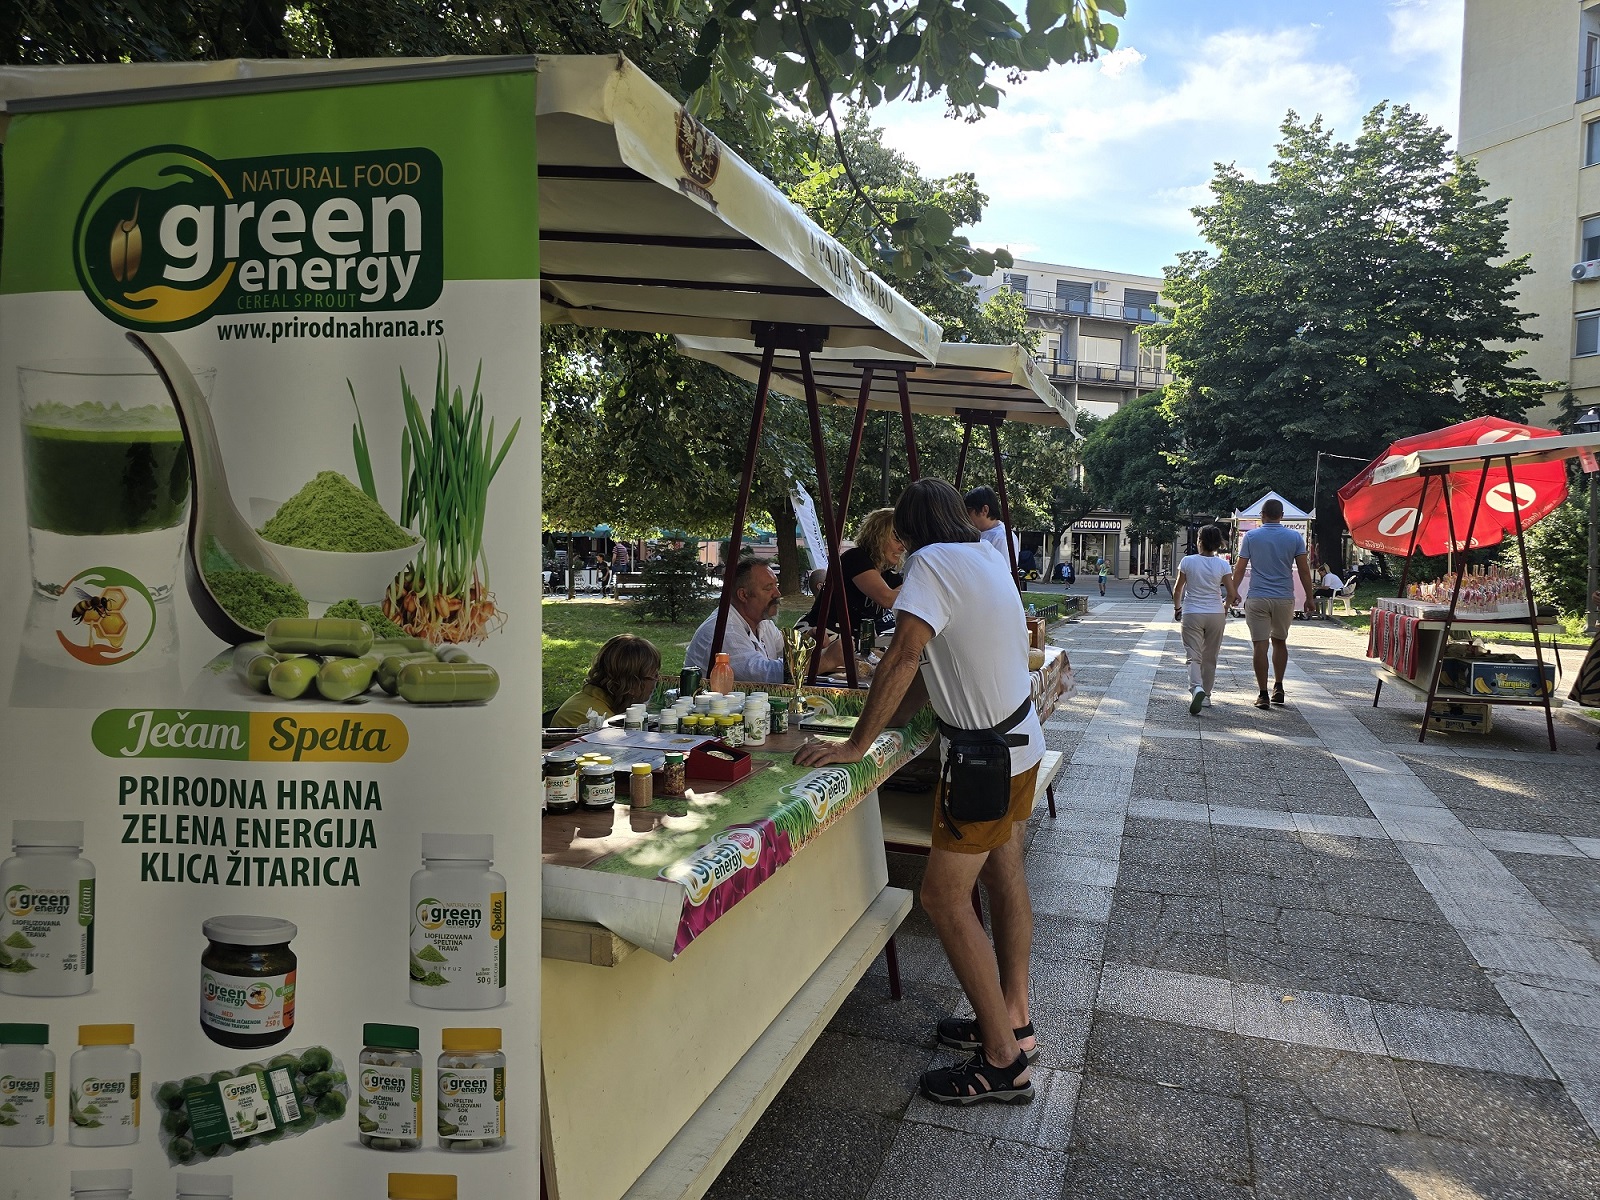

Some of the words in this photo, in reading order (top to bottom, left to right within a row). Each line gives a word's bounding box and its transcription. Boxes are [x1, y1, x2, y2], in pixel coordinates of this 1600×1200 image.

[242, 165, 347, 192] NATURAL
[354, 162, 421, 187] FOOD
[159, 193, 422, 282] green
[238, 255, 420, 302] energy
[237, 295, 291, 310] CEREAL
[294, 293, 357, 308] SPROUT
[217, 316, 444, 343] www.prirodnahrana.rs
[1074, 520, 1099, 530] PICCOLO
[1100, 520, 1121, 530] MONDO
[120, 710, 246, 756] Ječam
[269, 717, 391, 762] Spelta
[119, 776, 267, 810] PRIRODNA
[277, 780, 383, 810] HRANA
[828, 774, 849, 800] energy
[121, 814, 227, 847] ZELENA
[235, 818, 377, 849] ENERGIJA
[141, 852, 219, 885] KLICA
[225, 850, 360, 887] ŽITARICA
[714, 851, 742, 880] energy
[20, 894, 70, 909] green
[34, 905, 69, 914] energy
[431, 907, 481, 922] green
[491, 900, 505, 932] Spelta
[446, 919, 481, 928] energy
[208, 982, 247, 999] green
[217, 994, 247, 1007] energy
[221, 1010, 233, 1018] MED
[9, 1080, 40, 1089] green
[92, 1081, 125, 1092] green
[230, 1083, 257, 1095] green
[371, 1075, 405, 1087] green
[381, 1085, 405, 1093] energy
[450, 1078, 487, 1089] green
